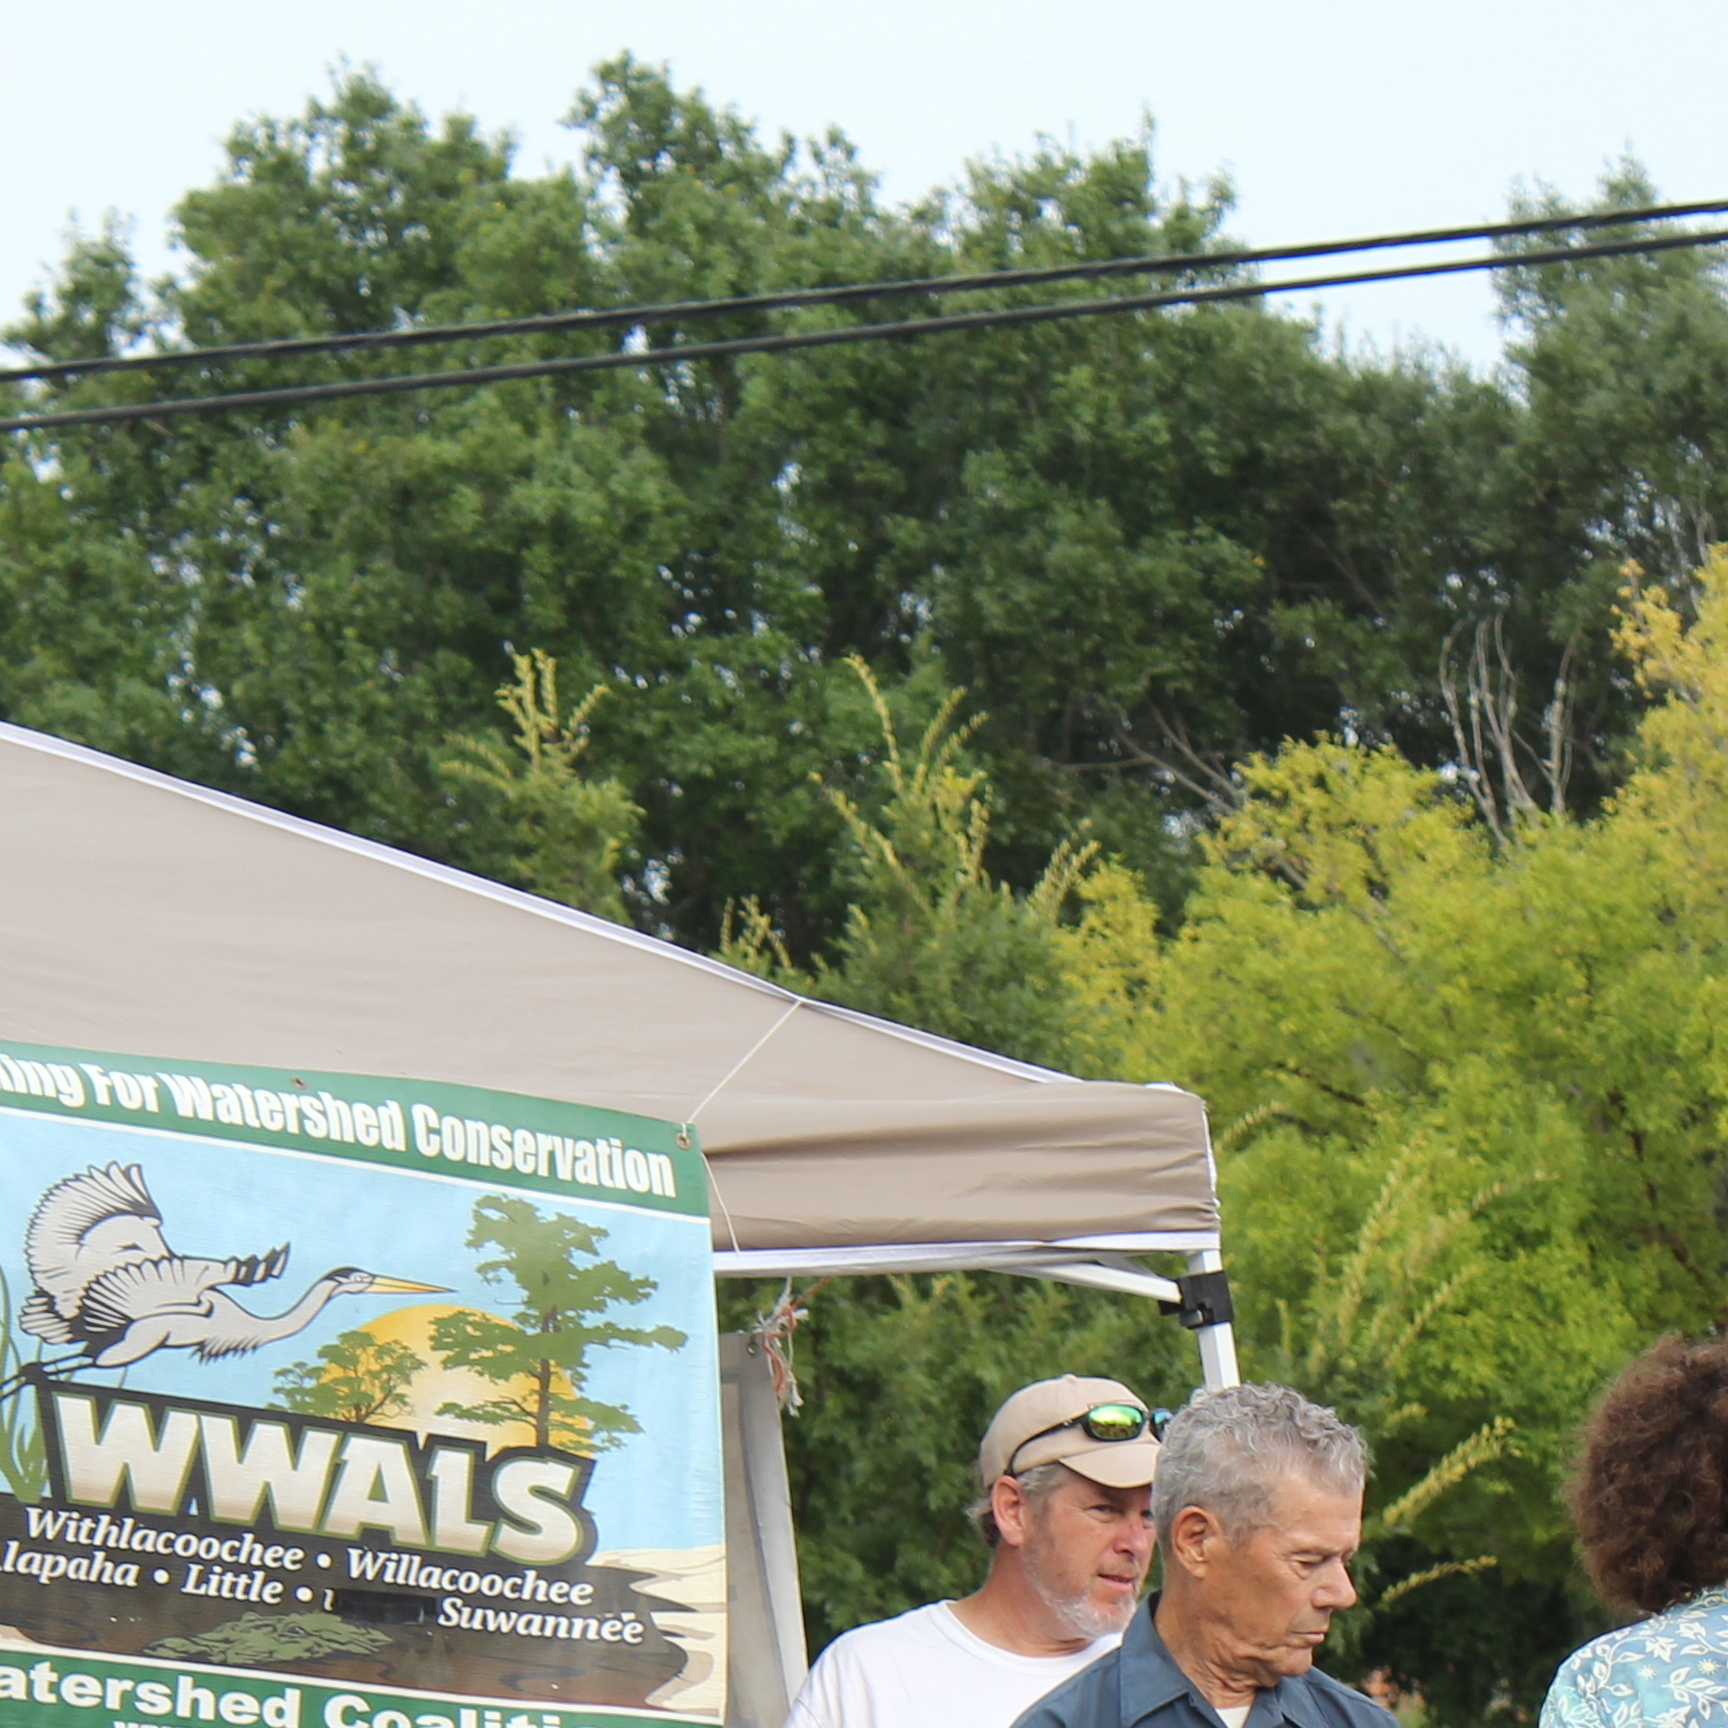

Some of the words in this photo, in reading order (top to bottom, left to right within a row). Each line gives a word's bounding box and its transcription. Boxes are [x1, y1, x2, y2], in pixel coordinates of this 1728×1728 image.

[78, 1063, 160, 1113] For
[156, 1071, 408, 1152] Watershed
[411, 1102, 677, 1198] Conservation
[53, 1392, 584, 1566] WWALS
[25, 1506, 306, 1571] Withlacoochee
[346, 1547, 595, 1606] Willacoochee
[180, 1563, 285, 1604] Little
[437, 1596, 646, 1644] Suwannee
